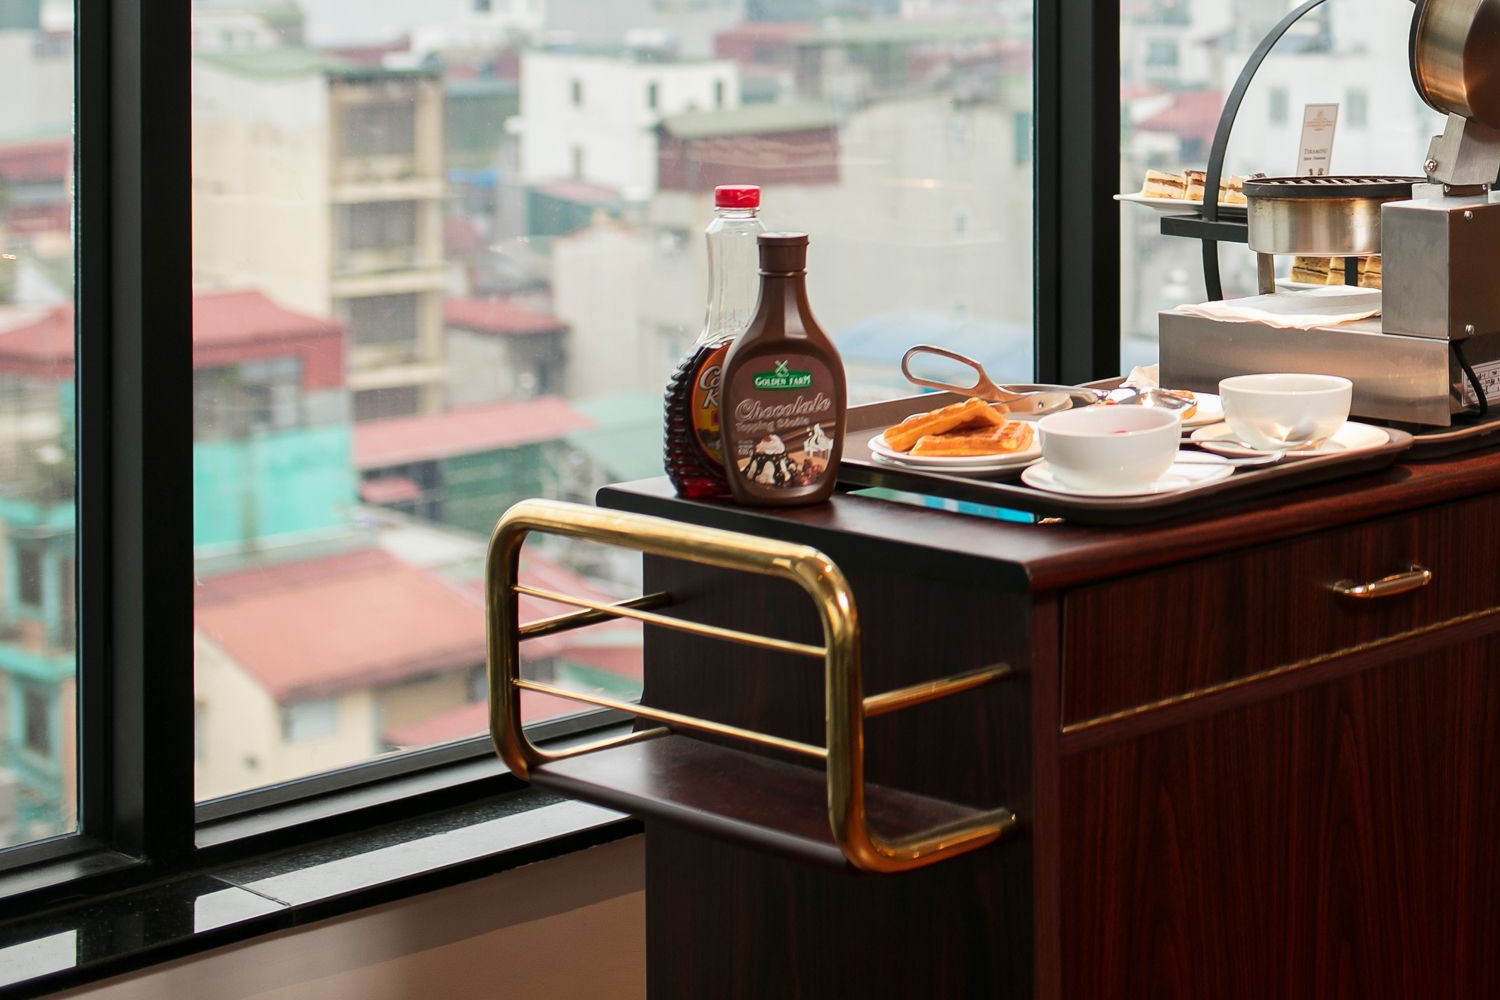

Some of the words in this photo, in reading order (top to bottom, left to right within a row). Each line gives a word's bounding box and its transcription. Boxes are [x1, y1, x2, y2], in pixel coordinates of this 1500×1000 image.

[755, 376, 786, 387] GOLDEN
[789, 374, 812, 385] FARM
[735, 392, 832, 420] Chocolate
